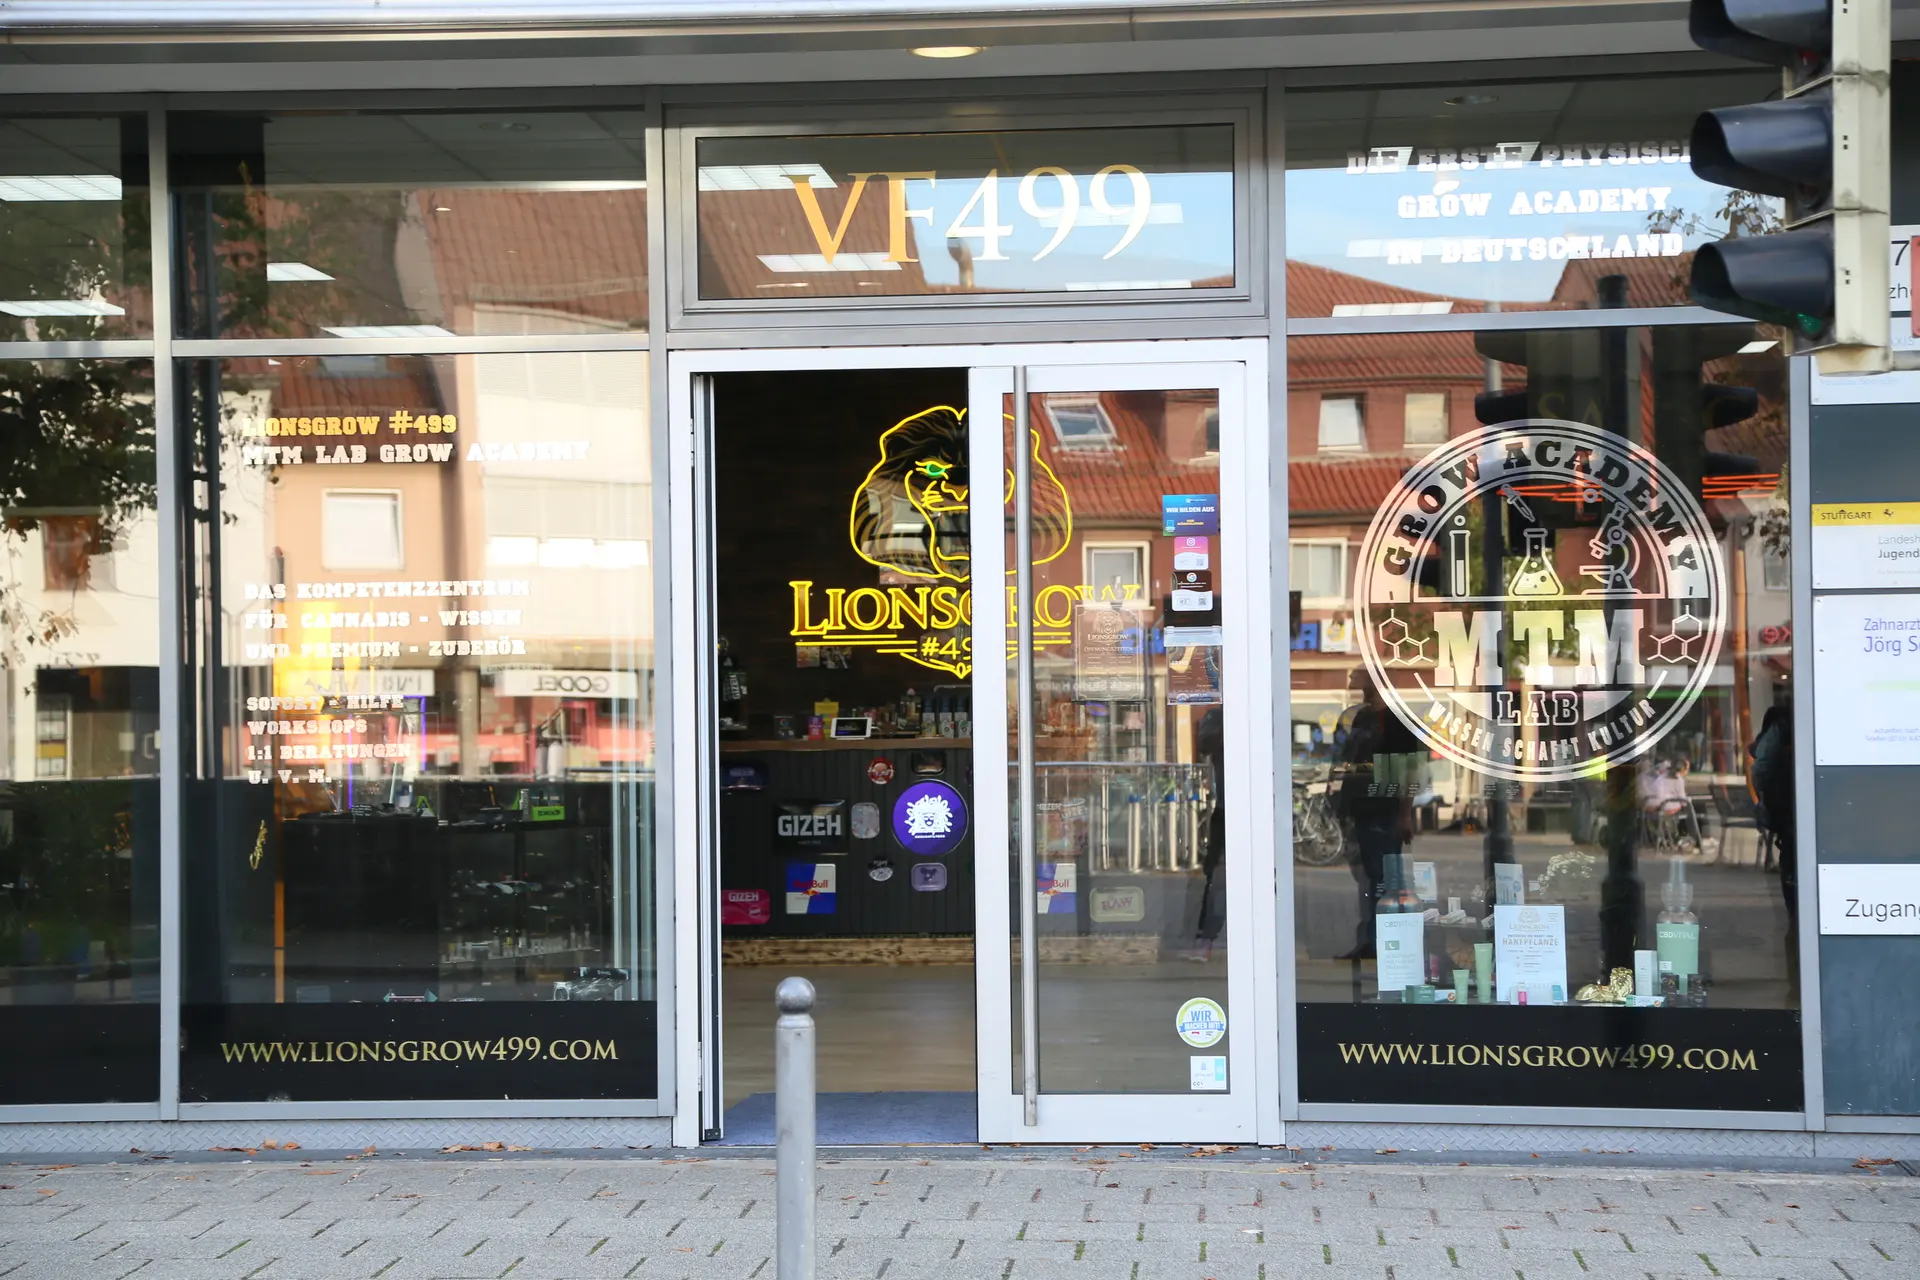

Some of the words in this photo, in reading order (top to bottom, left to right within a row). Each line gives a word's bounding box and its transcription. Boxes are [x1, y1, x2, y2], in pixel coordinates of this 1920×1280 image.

[1346, 150, 1399, 174] DIE
[1416, 147, 1523, 172] ERSTE
[779, 163, 1153, 265] VF499
[1397, 191, 1492, 219] GROW
[1509, 186, 1672, 216] ACADEMY
[1387, 240, 1423, 265] IN
[1440, 232, 1683, 264] DEUTSCHLAND
[242, 416, 380, 437] LIONSGROW
[388, 410, 457, 434] #499
[242, 445, 303, 465] MTM
[315, 444, 367, 464] LAB
[379, 443, 453, 464] GROW
[466, 440, 590, 462] ACADEMY
[1383, 452, 1481, 576] GROW
[1502, 440, 1699, 572] ACADEMY
[244, 583, 287, 599] DAS
[296, 580, 530, 599] KOMPETENZZENTRUM
[244, 609, 288, 629] FÜR
[300, 612, 411, 628] CANNABIS
[438, 610, 522, 627] WISSEN
[245, 643, 290, 659] UND
[300, 641, 400, 658] PREMIUM
[428, 636, 526, 657] ZUBEHÖR
[1433, 608, 1646, 687] MTM
[1863, 636, 1902, 656] Jörg
[1908, 635, 1920, 652] S
[246, 695, 321, 711] SOFORT
[1496, 690, 1579, 727] LAB
[247, 719, 368, 736] WORKSHOPS
[1428, 700, 1496, 753] WISSEN
[1502, 736, 1581, 761] SCHAFFT
[1587, 699, 1657, 752] KULTUR
[247, 745, 272, 761] 1:1
[280, 743, 412, 760] BERATUNGEN
[247, 770, 269, 785] U.
[277, 769, 300, 784] V.
[308, 768, 333, 784] M.
[777, 814, 842, 837] GIZEH
[812, 879, 829, 889] Bull
[728, 892, 759, 902] GIZEH
[1845, 898, 1920, 922] Zugan
[1502, 938, 1559, 946] HANFPFLANZE
[1659, 931, 1696, 940] CBDVITAL
[1190, 1010, 1212, 1022] WIR
[220, 1036, 619, 1064] WWW.LIONSGROW499.COM
[1337, 1042, 1759, 1072] WWW.LIONSGROW499.COM
